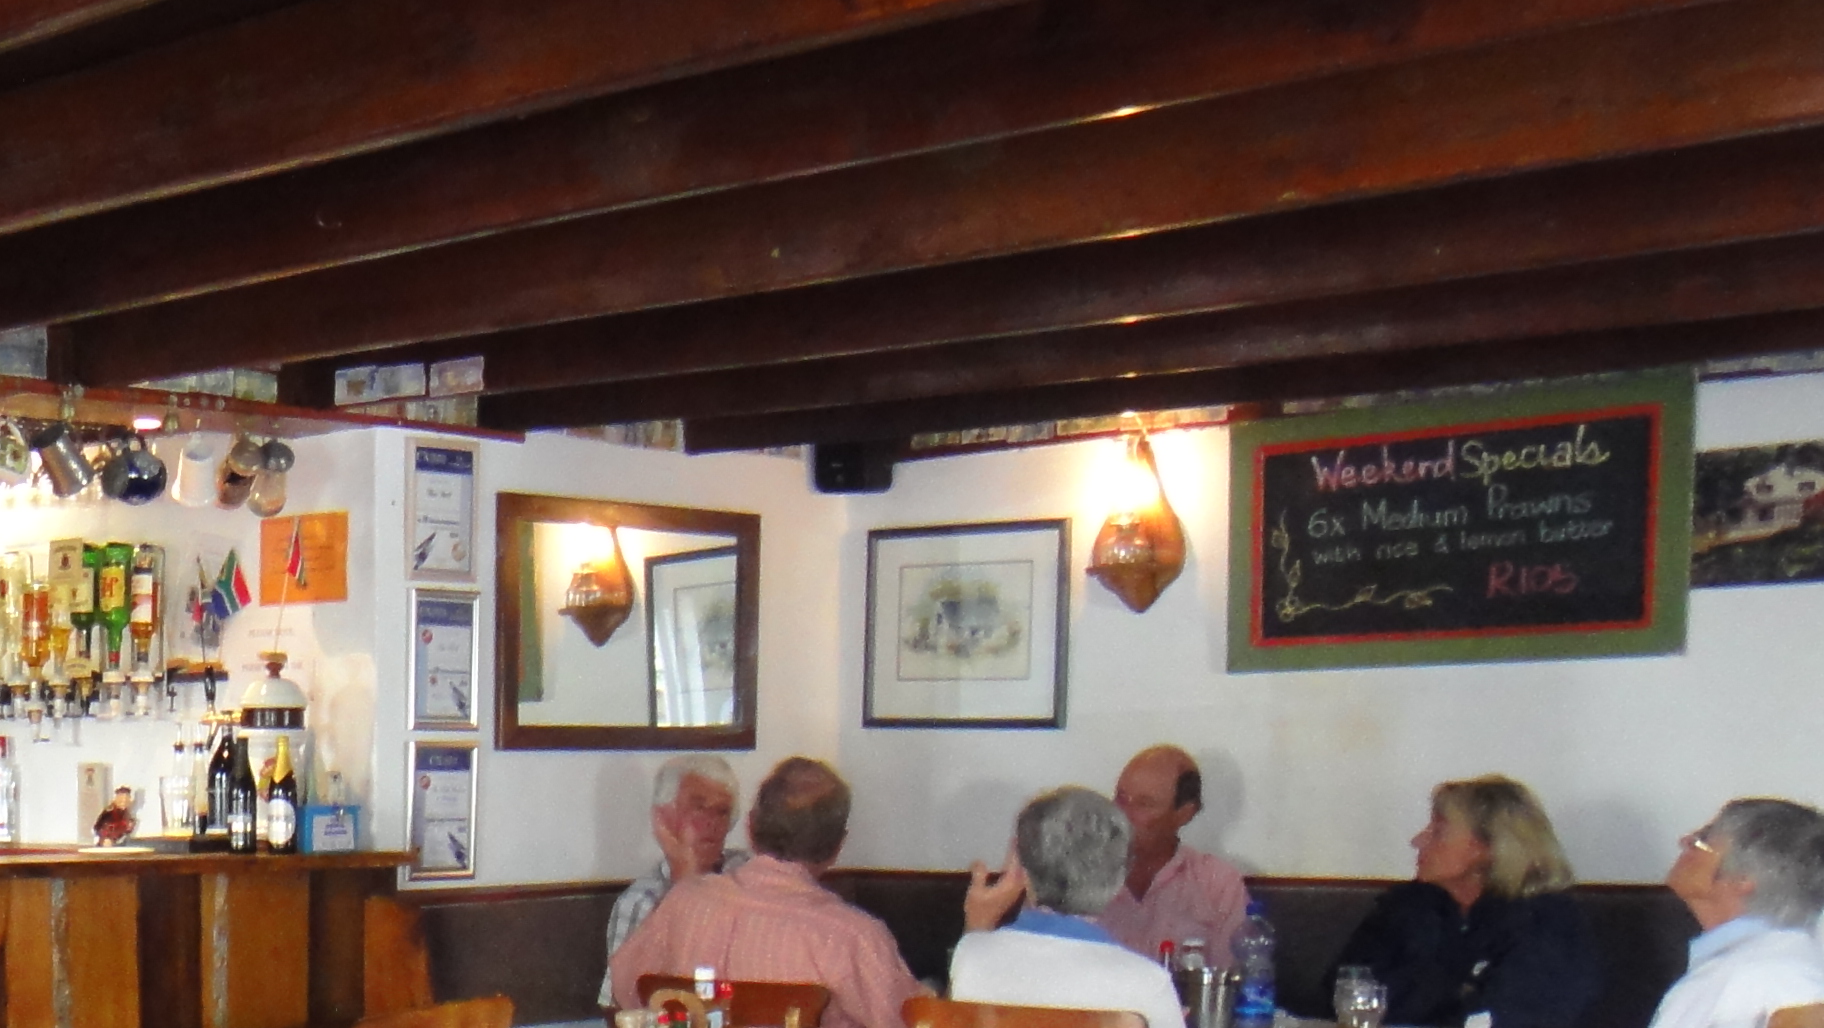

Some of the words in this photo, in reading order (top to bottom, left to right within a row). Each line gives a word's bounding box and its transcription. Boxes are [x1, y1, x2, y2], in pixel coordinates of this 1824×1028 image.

[1312, 440, 1456, 492] Weekend
[1461, 424, 1610, 486] Specials
[1308, 508, 1346, 538] 6x
[1363, 499, 1468, 529] Medium
[1488, 484, 1593, 519] Prawns
[1312, 545, 1361, 565] with
[1376, 540, 1419, 560] rice
[1460, 529, 1526, 551] lemon
